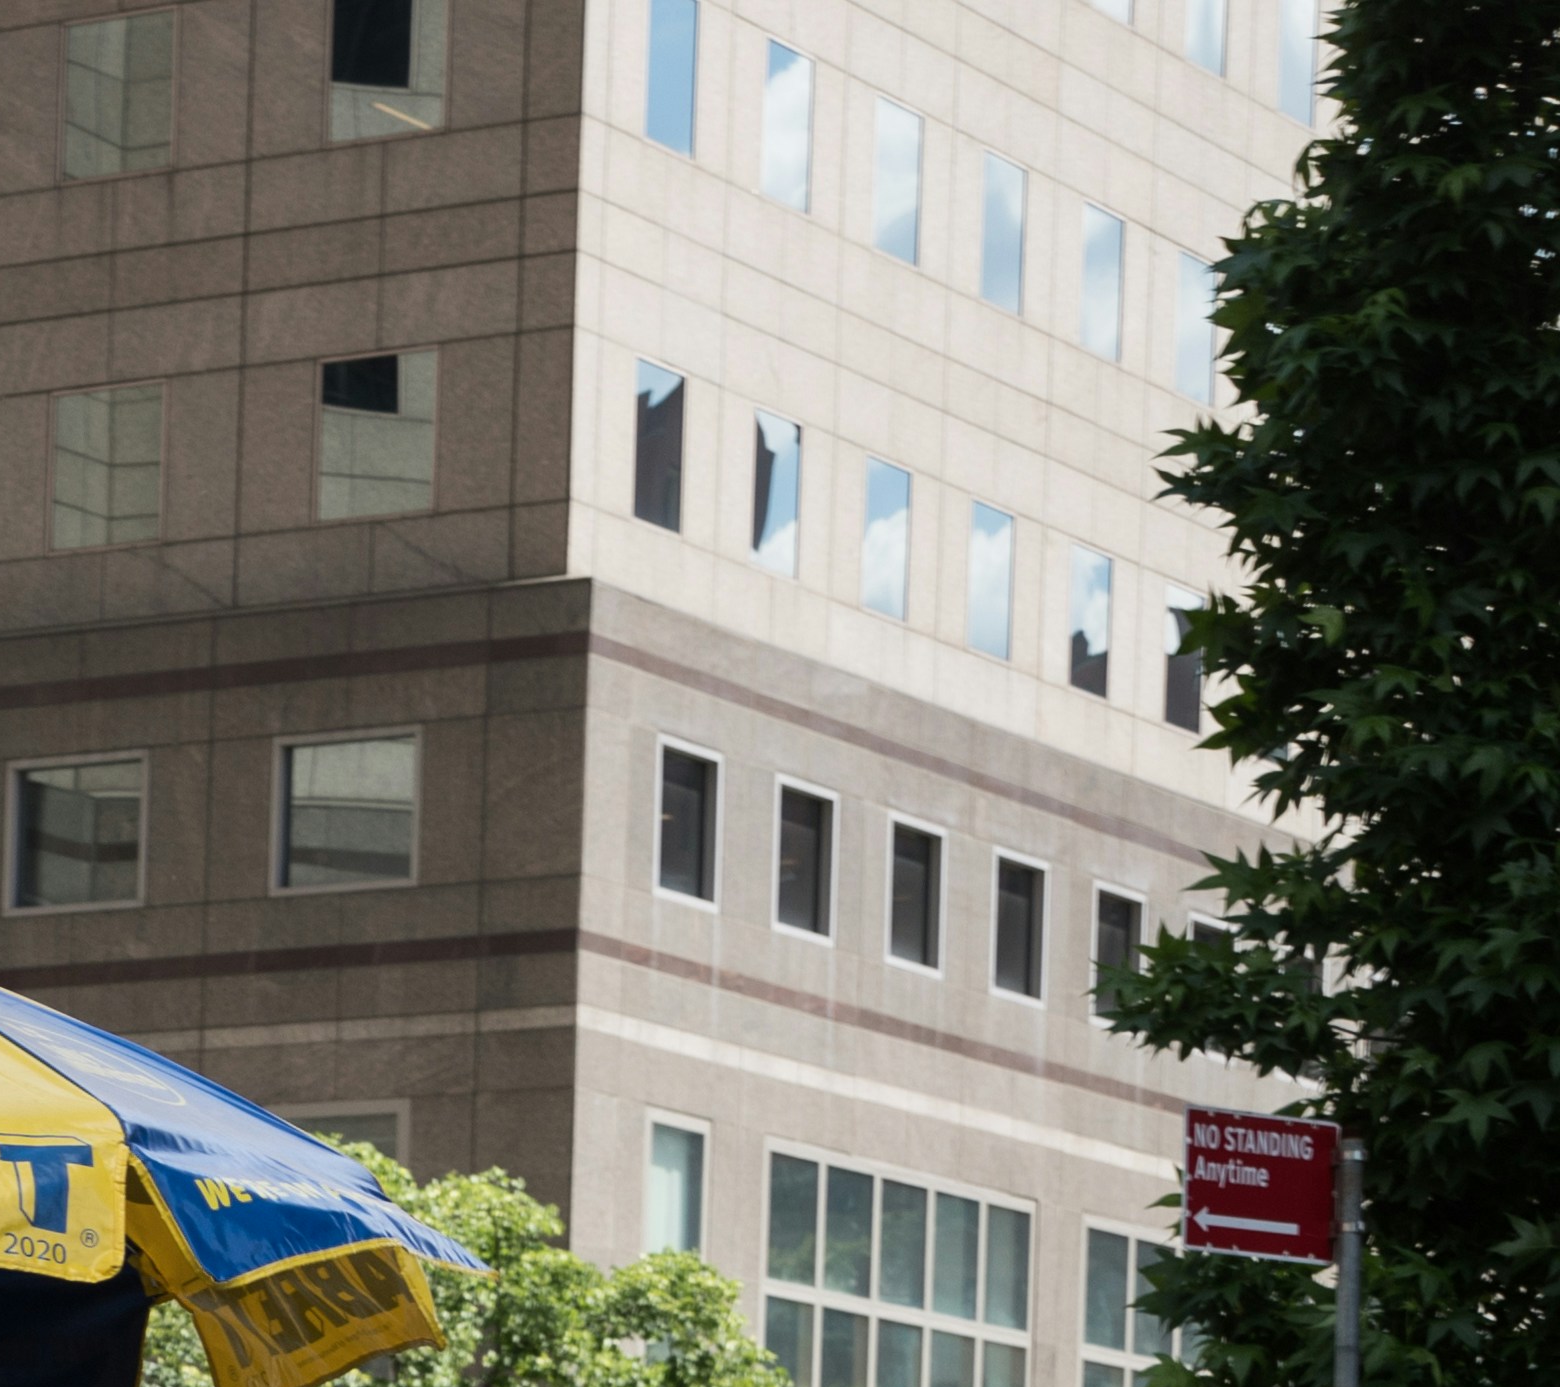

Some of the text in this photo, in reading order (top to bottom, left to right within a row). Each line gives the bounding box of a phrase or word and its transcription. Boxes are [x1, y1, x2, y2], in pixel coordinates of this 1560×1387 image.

[1194, 1122, 1314, 1160] NO STANDING
[1194, 1155, 1270, 1188] Anytime
[4, 1232, 66, 1264] 2020
